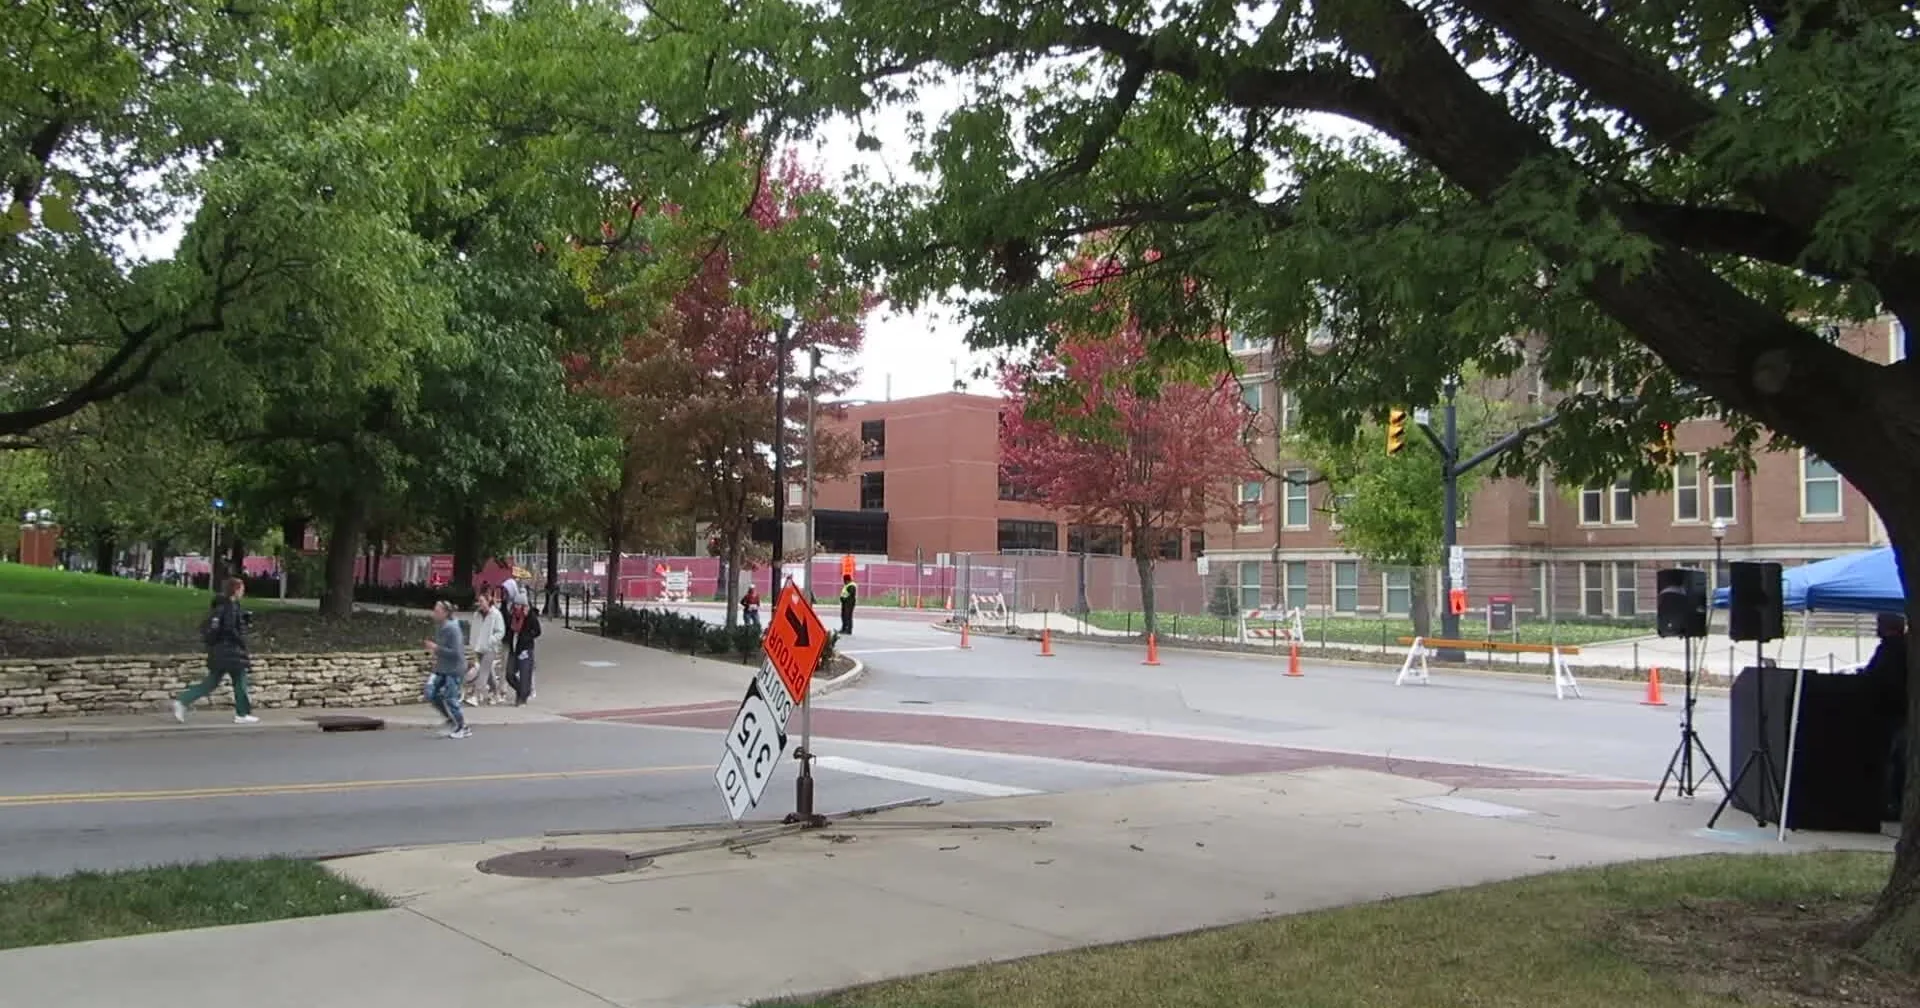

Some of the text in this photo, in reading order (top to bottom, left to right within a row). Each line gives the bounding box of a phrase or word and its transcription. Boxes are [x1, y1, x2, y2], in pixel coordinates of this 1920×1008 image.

[769, 629, 805, 695] DETOUR
[761, 664, 792, 724] SOUTH
[737, 712, 771, 779] 315
[725, 769, 743, 807] TO
